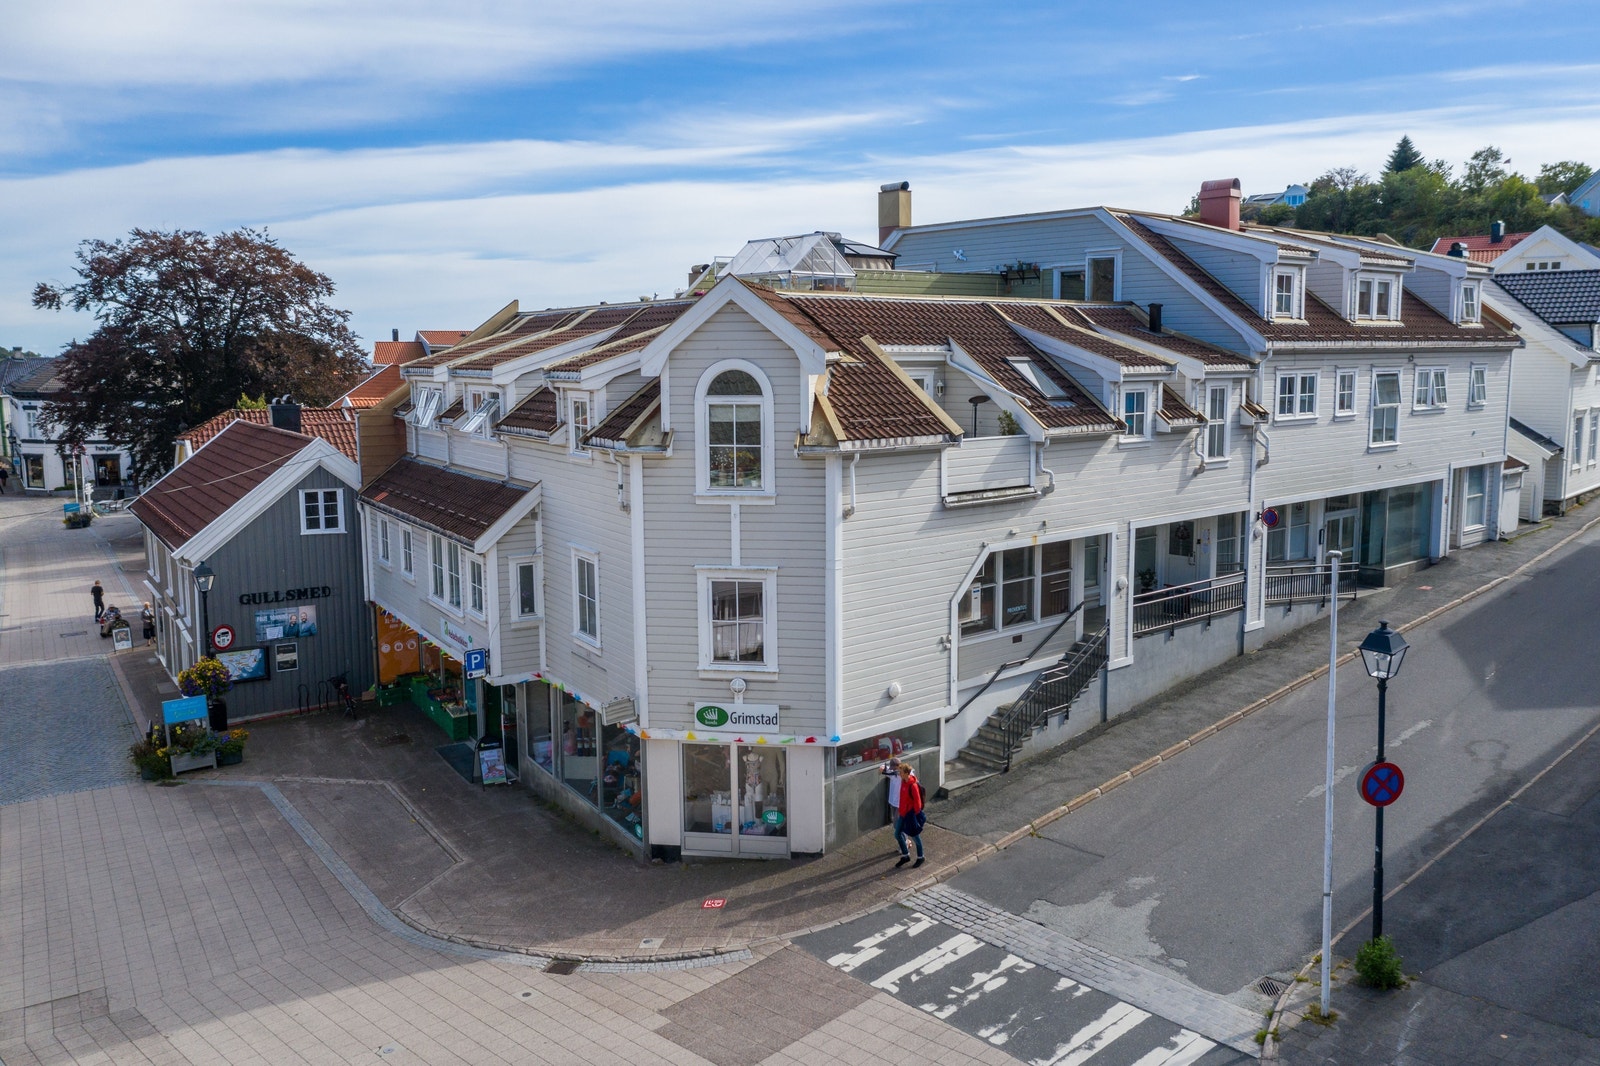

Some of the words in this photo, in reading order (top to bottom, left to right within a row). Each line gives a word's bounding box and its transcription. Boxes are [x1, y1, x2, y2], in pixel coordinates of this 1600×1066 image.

[239, 586, 331, 605] GULLSMED
[471, 654, 481, 669] P
[729, 711, 778, 726] Grimstad
